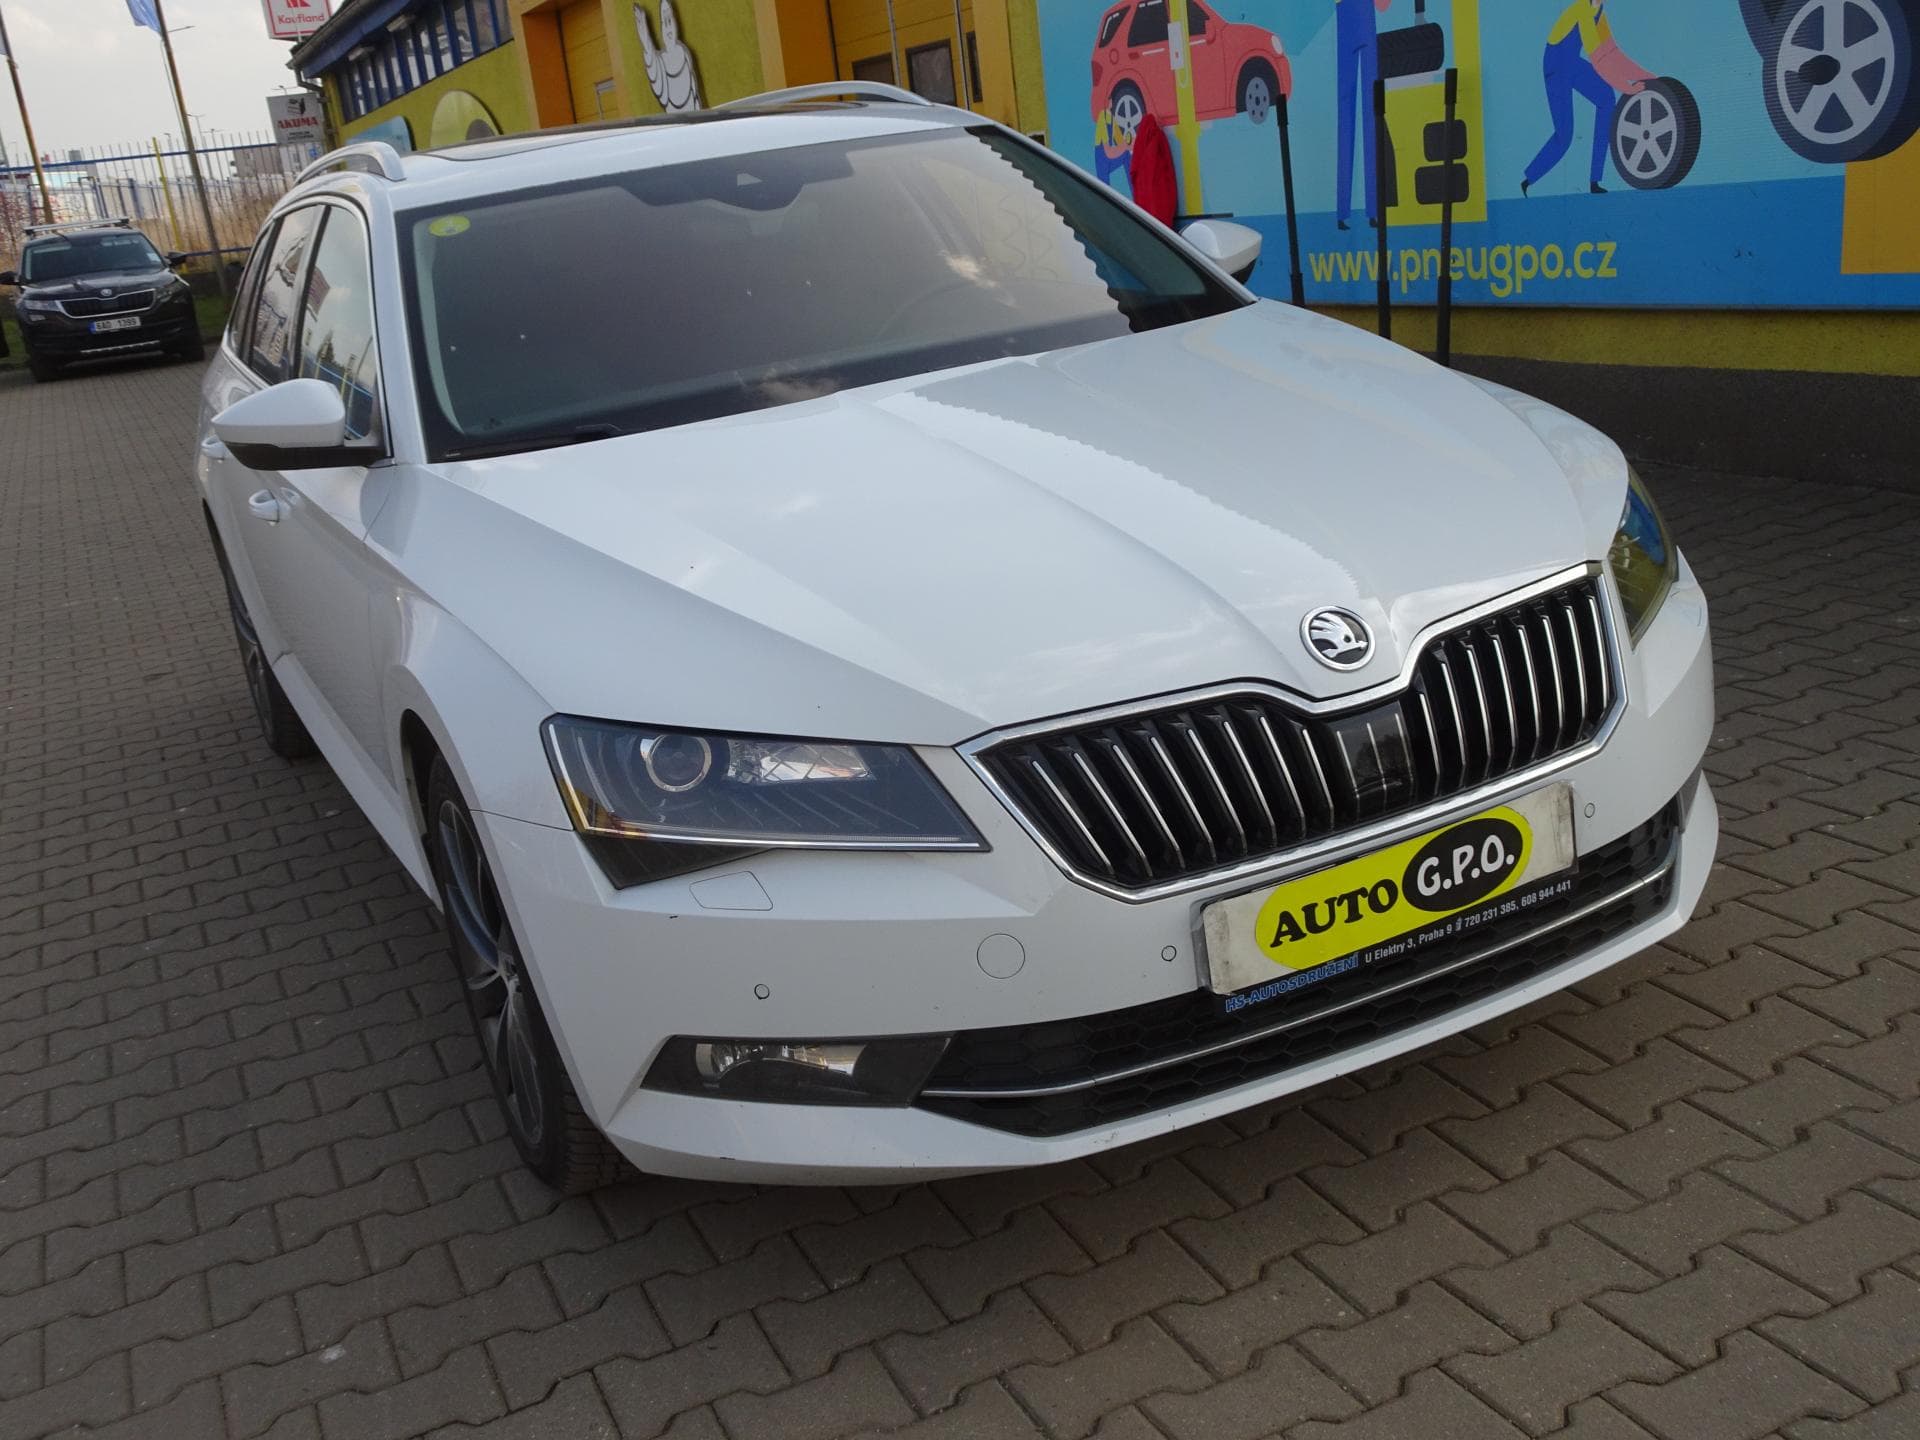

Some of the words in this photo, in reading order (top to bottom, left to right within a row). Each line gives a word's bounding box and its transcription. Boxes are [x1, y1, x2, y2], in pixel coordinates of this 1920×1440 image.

[277, 12, 325, 24] Kaufland
[277, 116, 319, 129] AKUMA
[1308, 241, 1618, 298] www.pneugpo.cz
[1269, 878, 1399, 948] AUTO
[1417, 834, 1516, 897] G.P.O.
[1225, 952, 1360, 1013] HS-AUTOSDRUŽENÍ
[1365, 951, 1373, 964] U
[1374, 942, 1405, 961] Elektry
[1419, 929, 1445, 945] Praha
[1446, 924, 1453, 936] 9
[1464, 915, 1481, 928] 720
[1482, 907, 1499, 922] 231
[1521, 893, 1537, 907] 608
[1538, 886, 1555, 901] 944
[1555, 879, 1572, 895] 441
